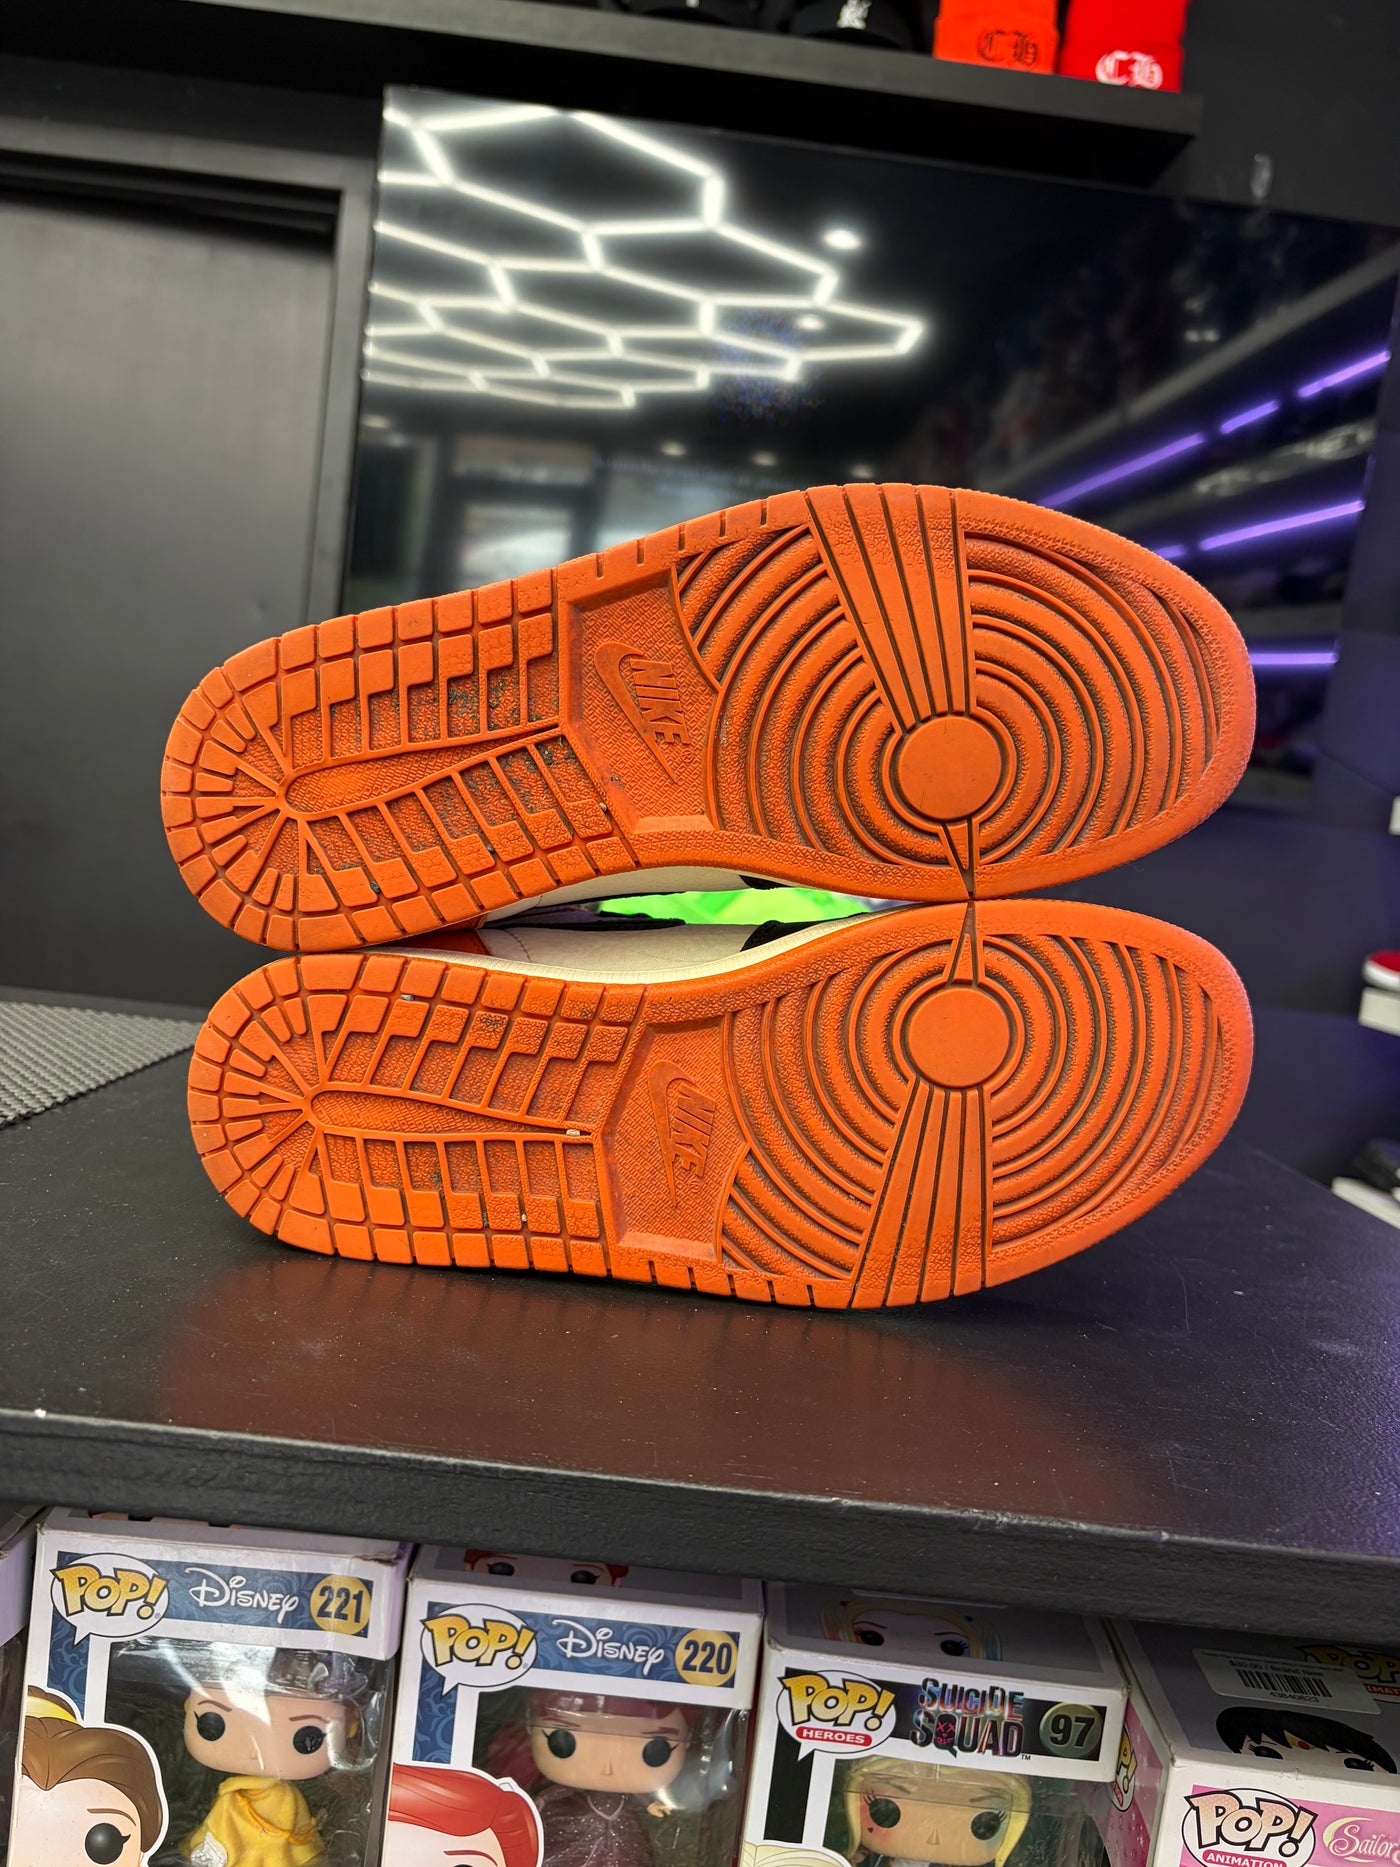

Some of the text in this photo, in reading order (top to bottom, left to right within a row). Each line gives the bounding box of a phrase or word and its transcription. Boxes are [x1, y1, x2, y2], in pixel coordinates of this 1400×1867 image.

[630, 658, 691, 745] NIKE
[671, 1082, 716, 1178] NIKE
[49, 1564, 170, 1620] POP!
[317, 1585, 364, 1623] 221
[420, 1614, 538, 1670] POP!
[682, 1640, 732, 1674] 220
[778, 1673, 896, 1731] POP!
[919, 1677, 1025, 1721] SUICIDE
[801, 1728, 866, 1744] HEROES
[910, 1710, 1025, 1758] SQUAD
[1050, 1714, 1096, 1747] 97
[1184, 1791, 1319, 1858] POP!
[1328, 1825, 1398, 1857] Sailor
